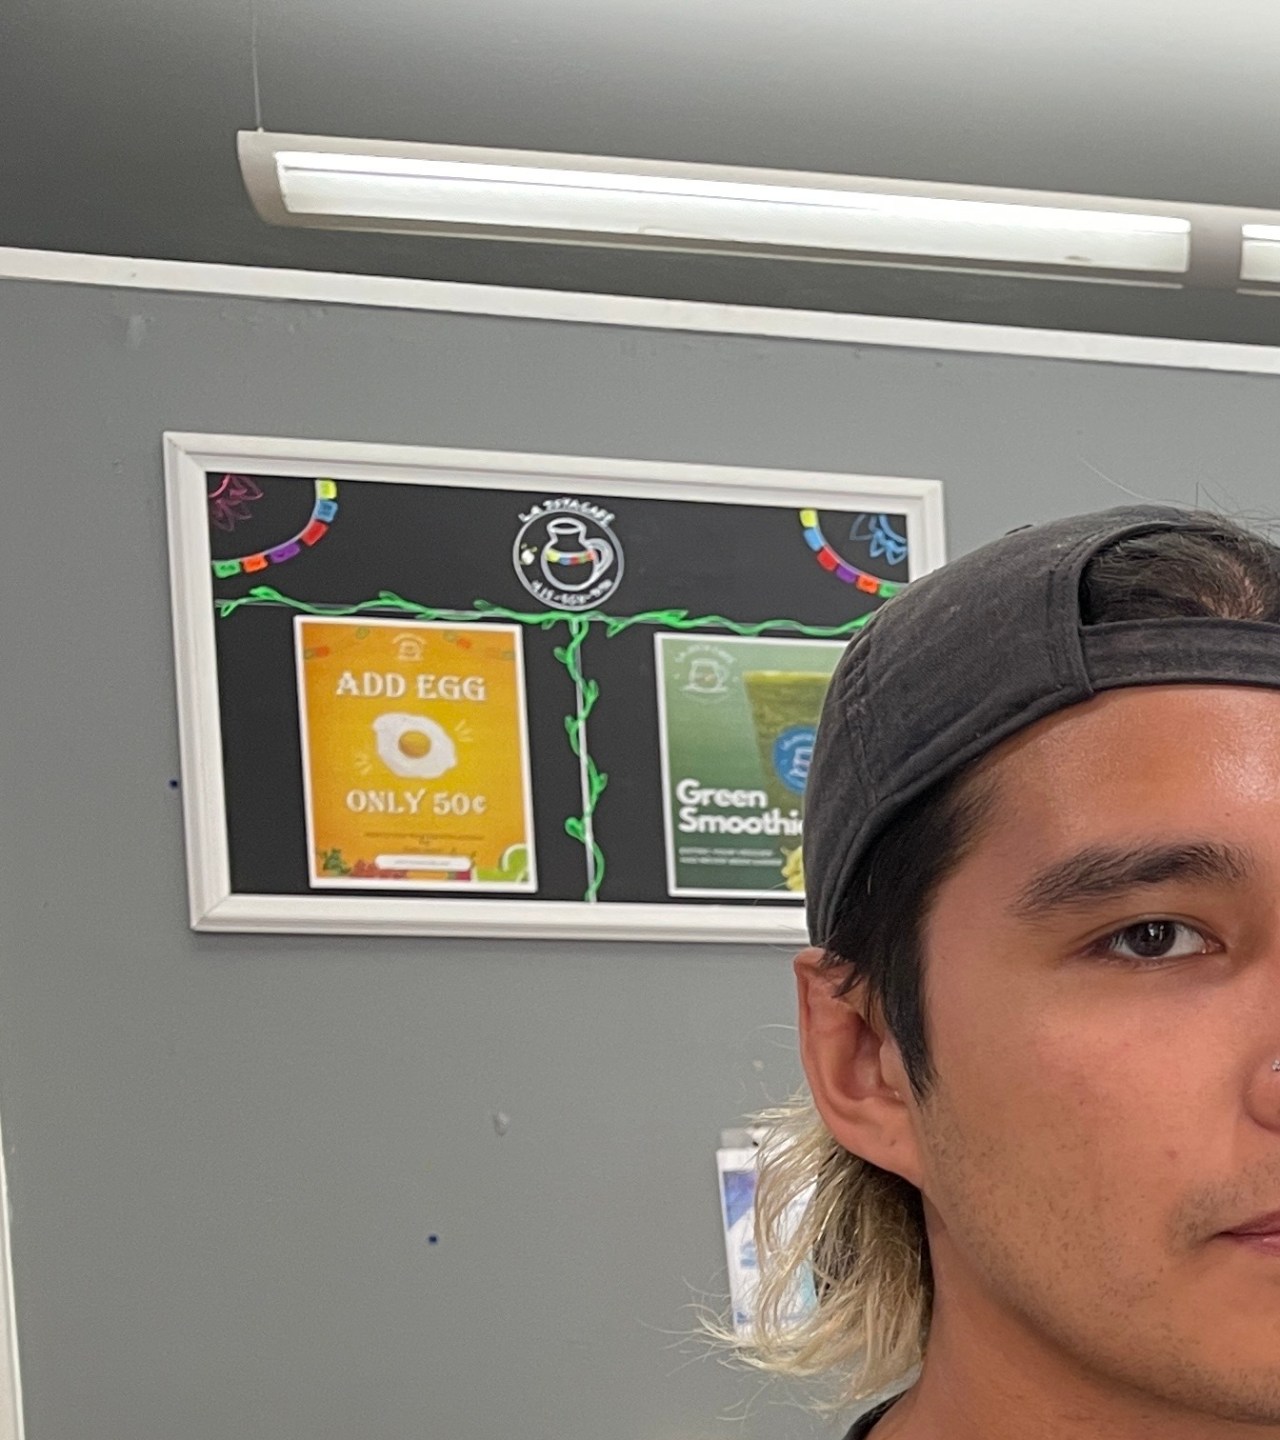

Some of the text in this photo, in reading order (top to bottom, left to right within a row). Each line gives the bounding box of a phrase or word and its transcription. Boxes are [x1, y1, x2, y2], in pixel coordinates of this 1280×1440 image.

[335, 671, 487, 701] ADD EGG
[345, 788, 487, 817] ONLY 50¢
[676, 778, 769, 809] Green
